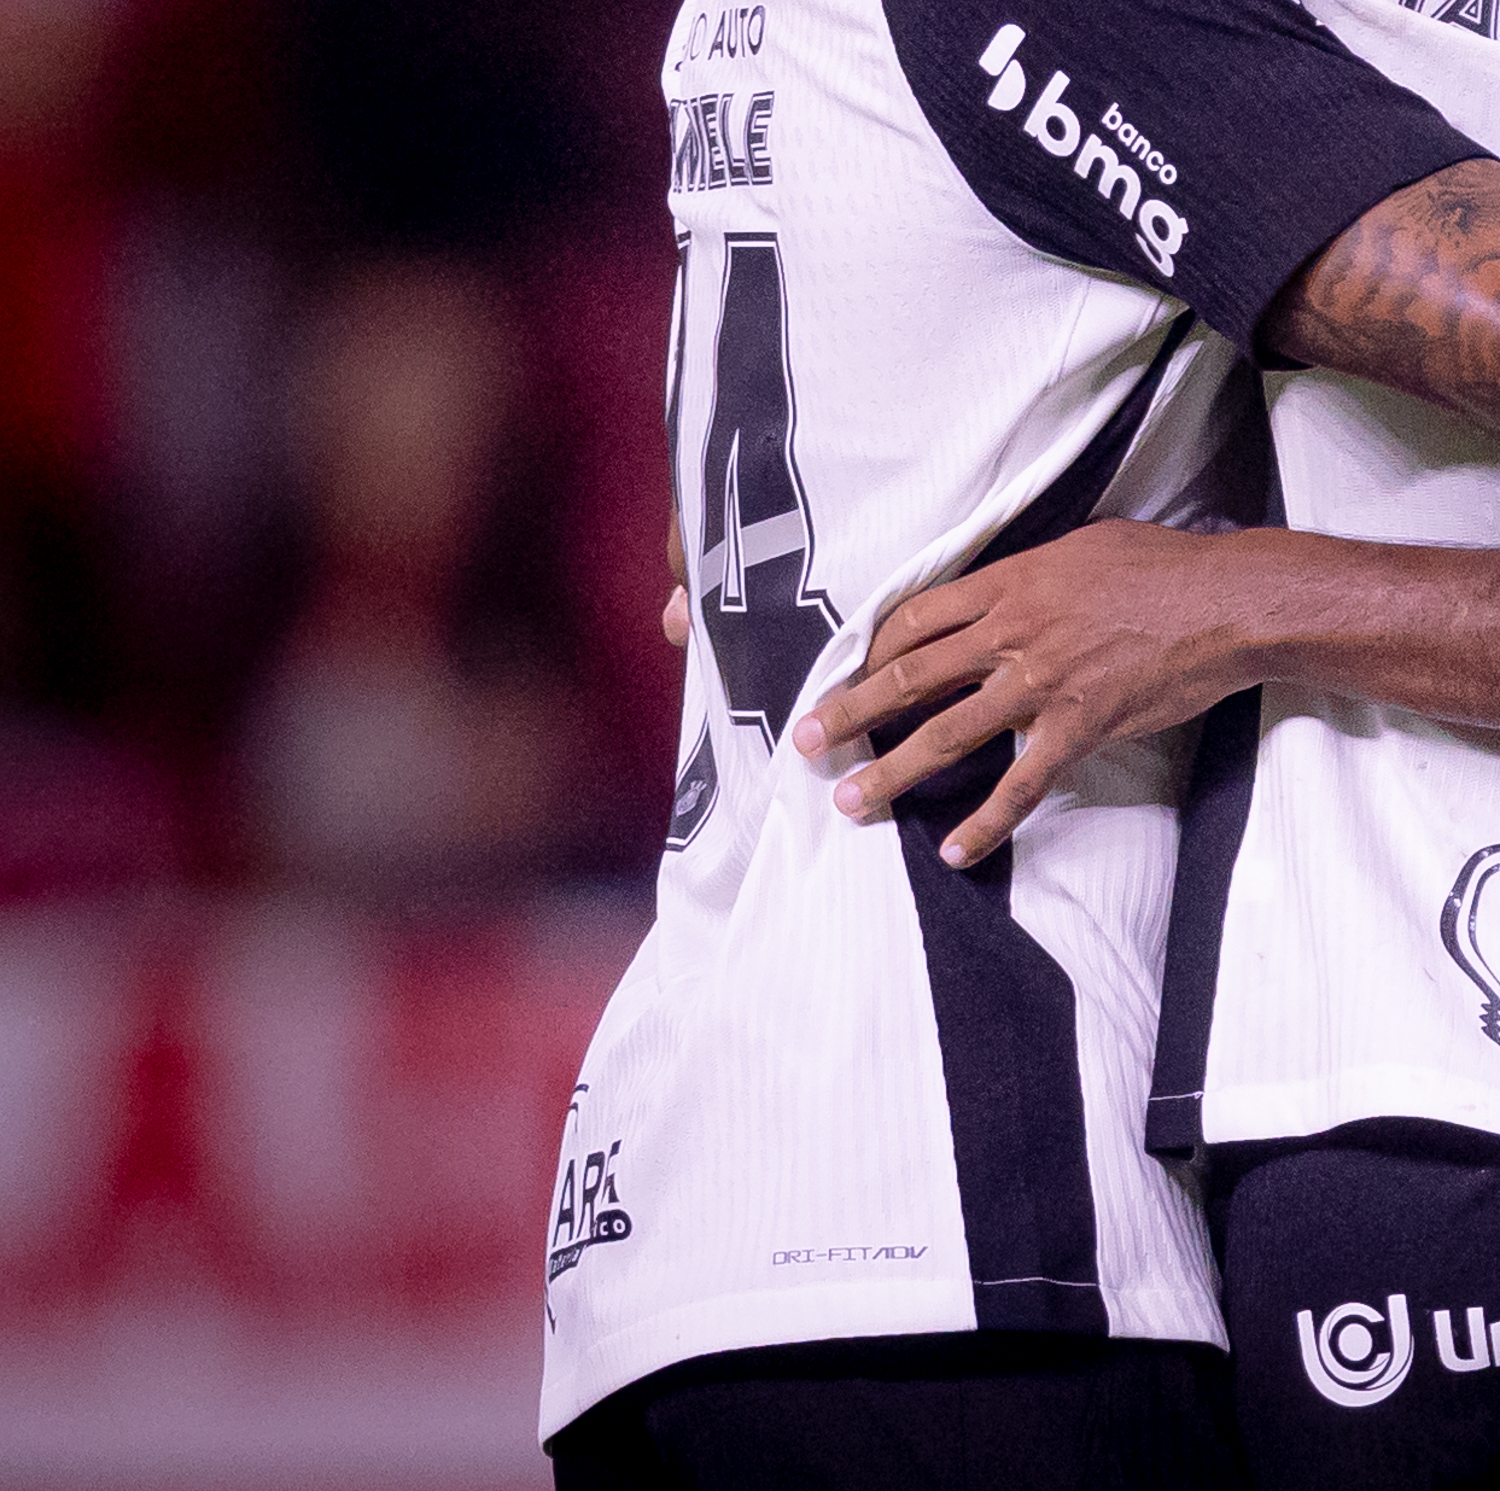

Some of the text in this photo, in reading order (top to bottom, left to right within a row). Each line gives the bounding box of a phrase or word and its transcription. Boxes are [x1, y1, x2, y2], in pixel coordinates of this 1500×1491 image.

[707, 4, 766, 60] AUTO
[1024, 70, 1189, 277] bmg
[1102, 102, 1177, 185] banco
